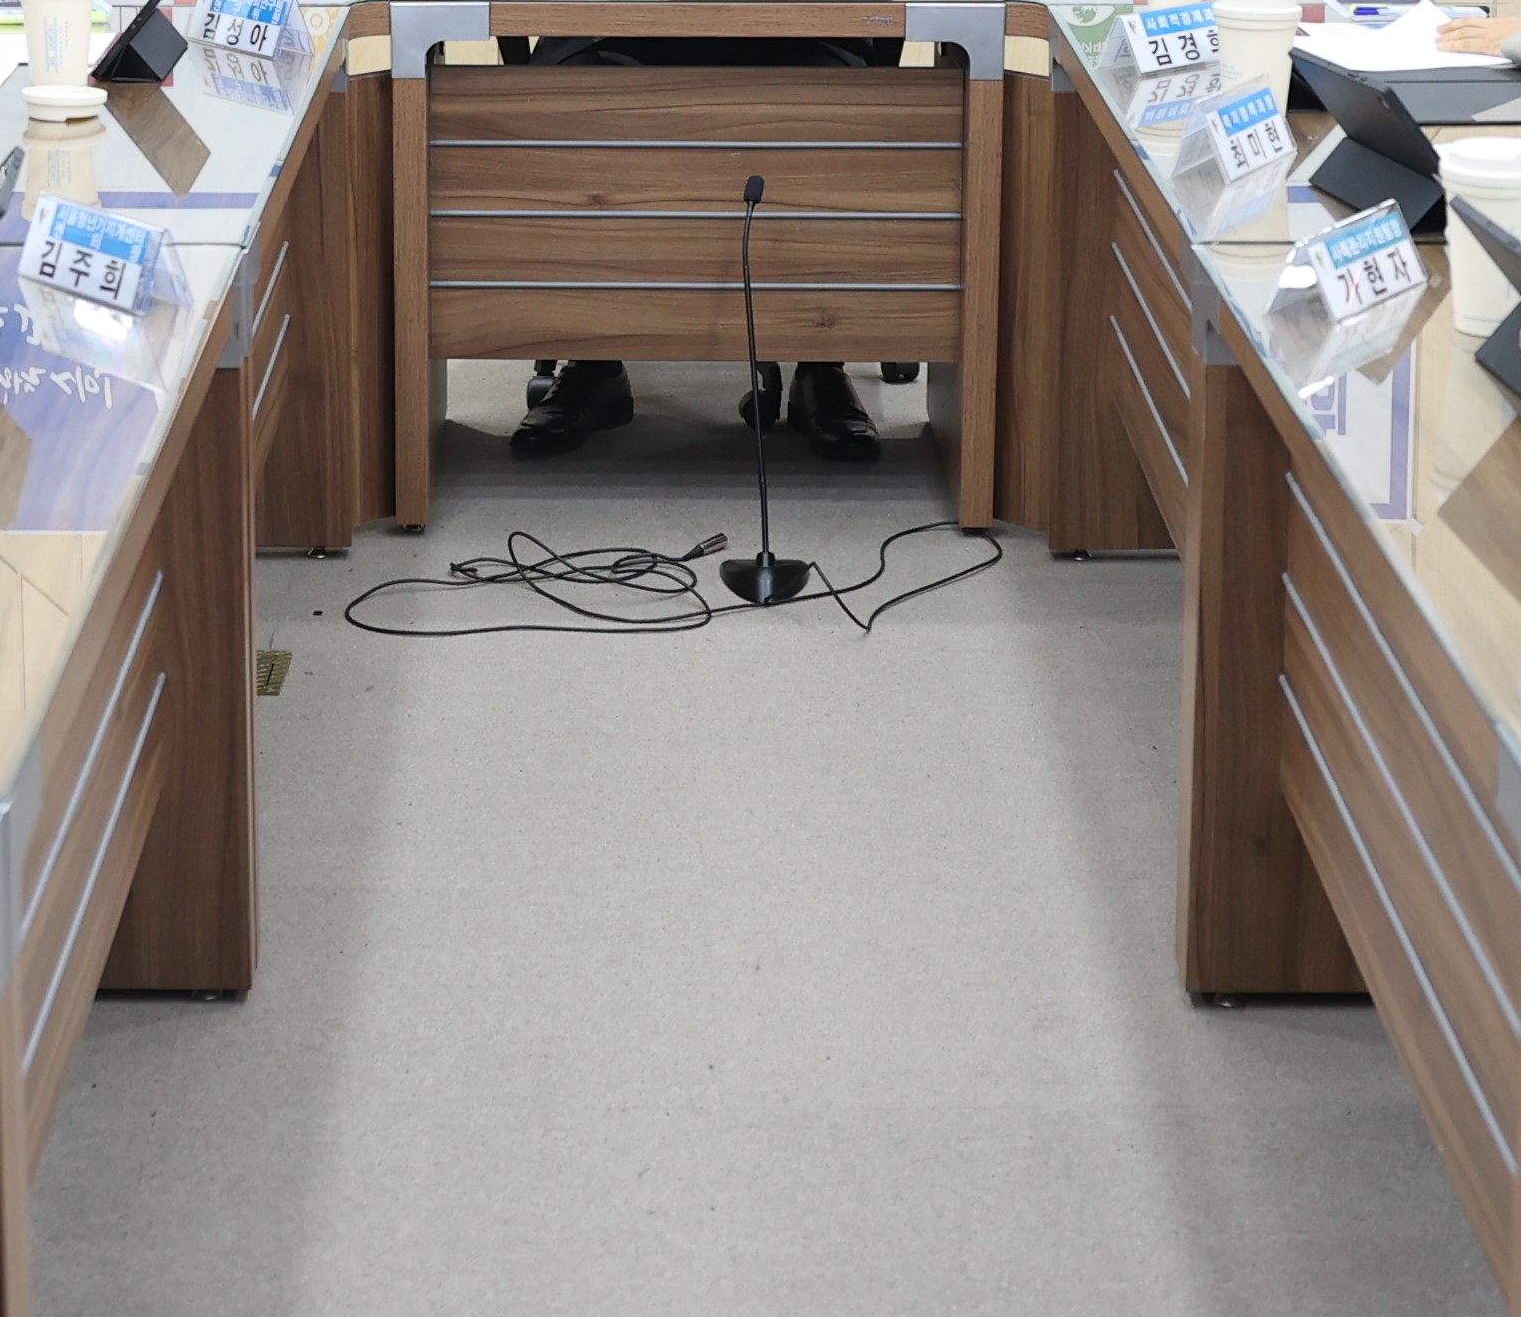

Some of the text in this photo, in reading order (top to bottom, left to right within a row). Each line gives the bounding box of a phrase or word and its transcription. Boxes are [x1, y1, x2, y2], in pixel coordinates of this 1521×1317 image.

[203, 12, 267, 52] 김성아
[1146, 7, 1215, 31] 사회적경제과
[1229, 120, 1284, 169] 최미현
[38, 240, 127, 300] 김주희
